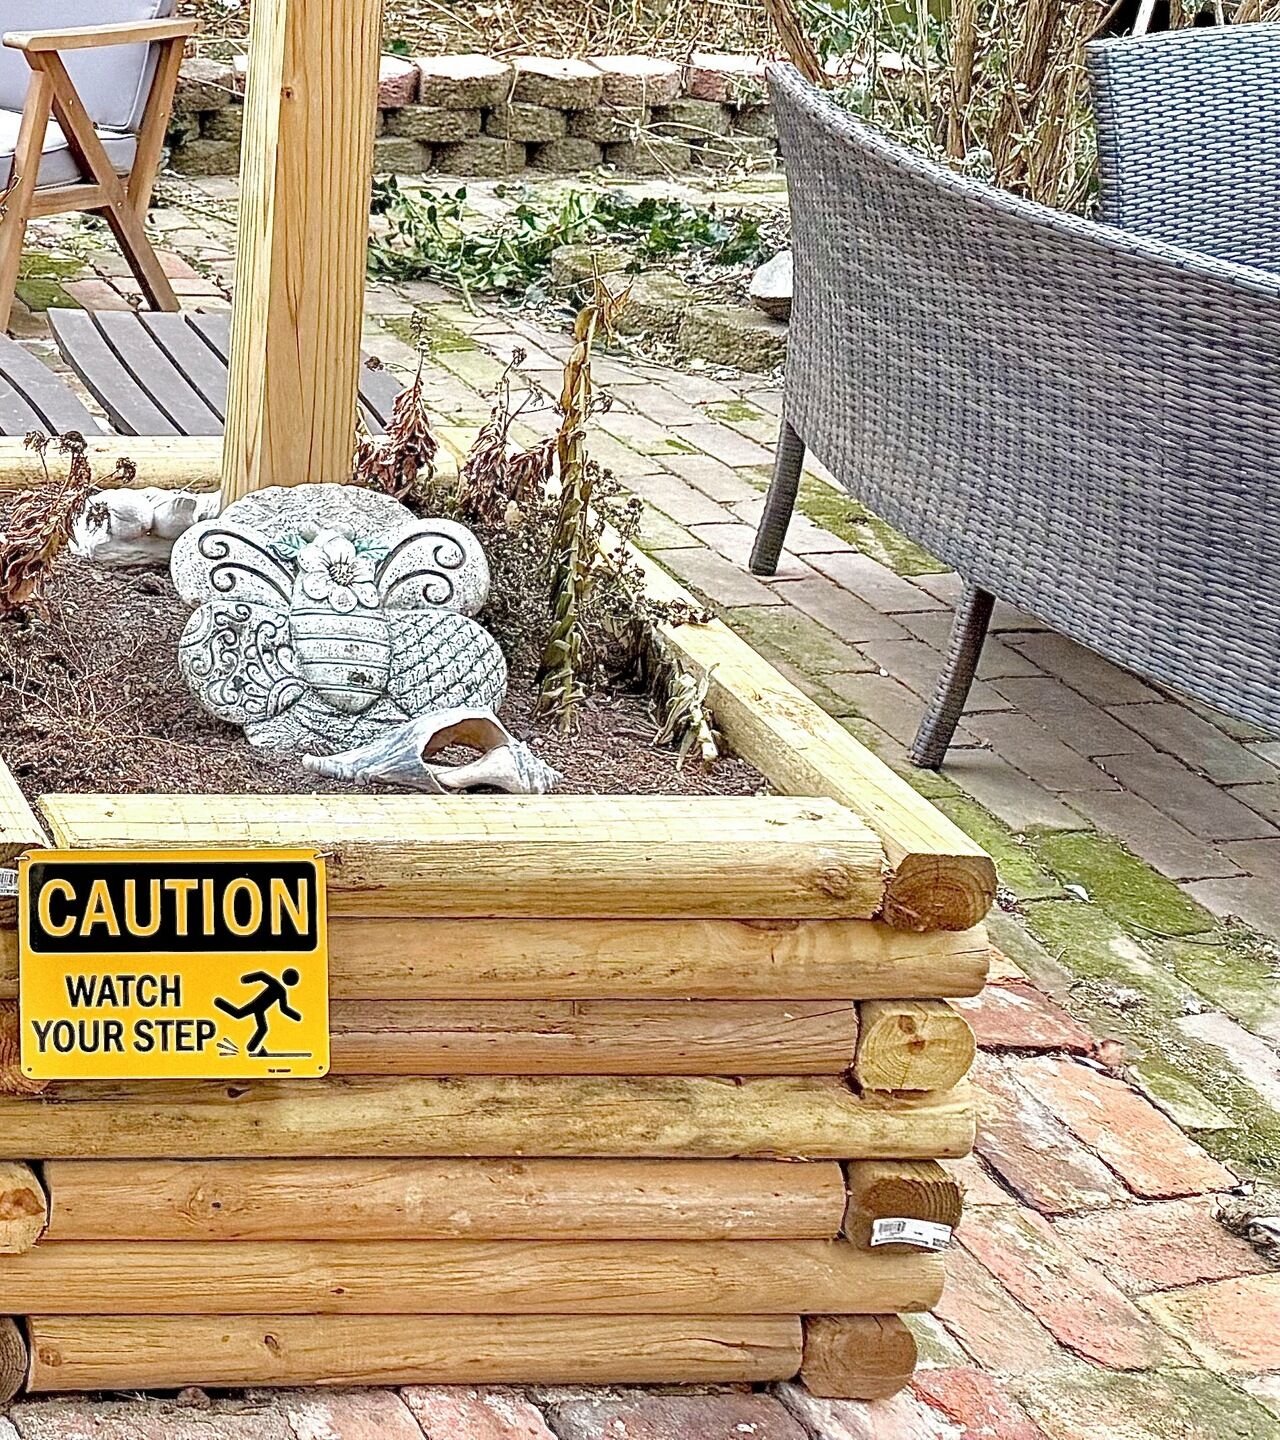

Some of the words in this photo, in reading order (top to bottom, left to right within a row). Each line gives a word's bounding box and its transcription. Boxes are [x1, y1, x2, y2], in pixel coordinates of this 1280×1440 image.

[38, 878, 309, 936] CAUTION
[65, 974, 181, 1007] WATCH
[32, 1019, 123, 1052] YOUR
[133, 1019, 216, 1052] STEP
